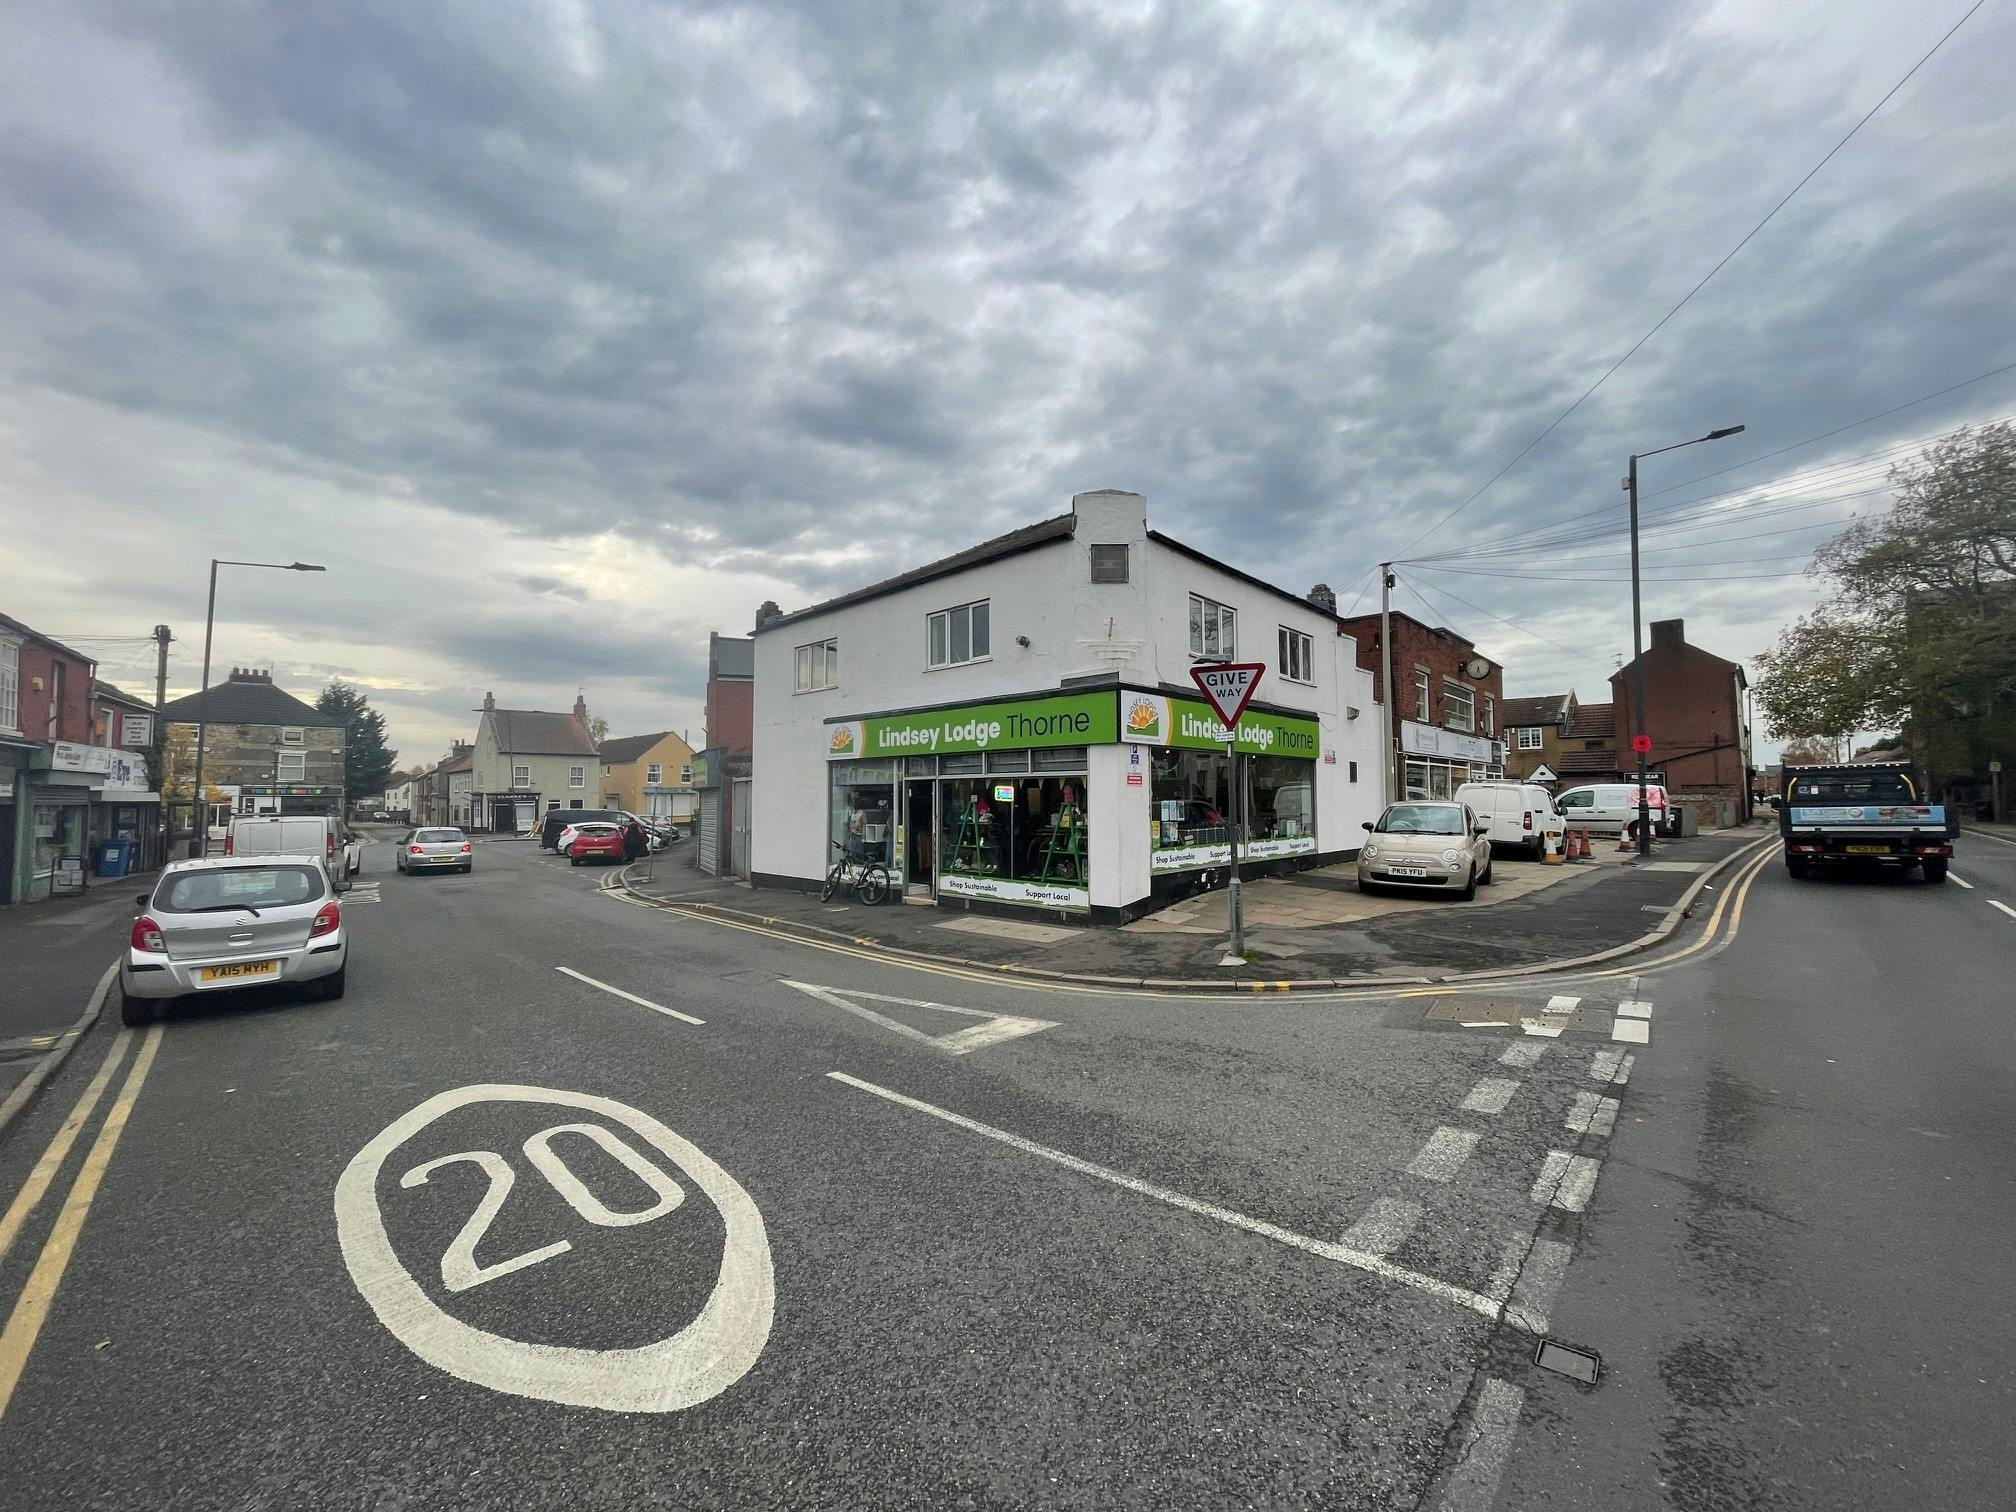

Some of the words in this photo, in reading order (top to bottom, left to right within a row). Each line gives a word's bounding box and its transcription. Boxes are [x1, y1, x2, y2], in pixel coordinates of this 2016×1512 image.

[1206, 671, 1248, 686] GIVE
[1215, 688, 1242, 698] WAY
[879, 726, 940, 750] Lindsey
[944, 719, 1000, 747] Lodge
[1007, 712, 1090, 738] Thorne
[1181, 712, 1236, 739] Lindse
[1238, 722, 1274, 751] Lodge
[1276, 726, 1314, 750] Thorne
[1155, 856, 1169, 865] Shop
[1169, 853, 1196, 862] Sustainable
[1209, 850, 1226, 859] Support
[1392, 867, 1408, 875] PK15
[1409, 868, 1423, 876] YFU
[949, 880, 963, 890] Shop
[964, 881, 997, 892] Sustainable
[1025, 889, 1052, 900] Support
[1053, 893, 1071, 901] Local
[209, 967, 240, 978] YA15
[243, 962, 269, 974] MYH
[400, 1123, 685, 1292] 20
